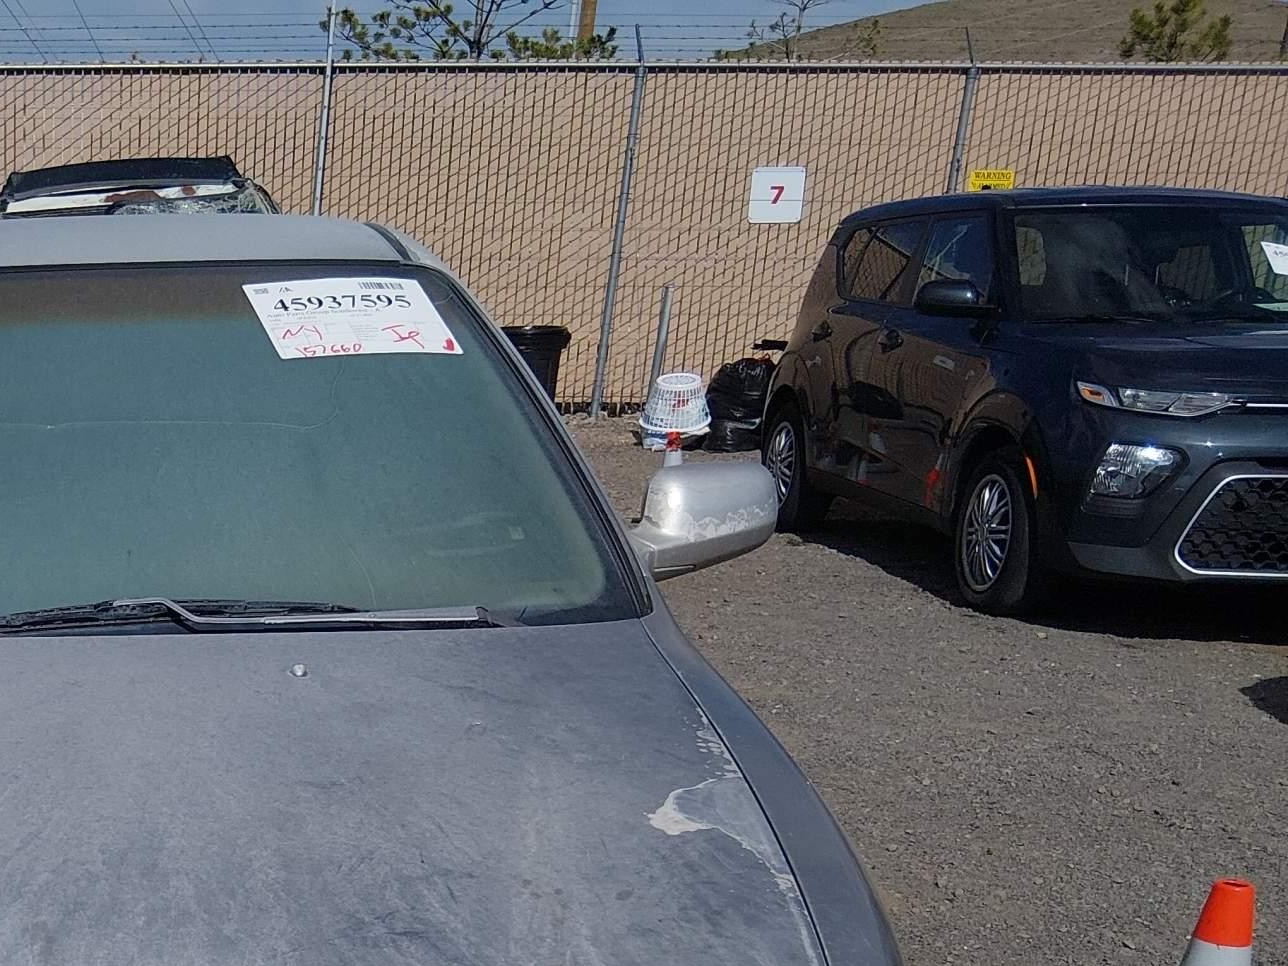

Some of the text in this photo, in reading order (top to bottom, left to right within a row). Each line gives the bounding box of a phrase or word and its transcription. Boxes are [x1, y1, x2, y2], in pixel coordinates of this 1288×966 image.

[974, 171, 1012, 180] WARNING
[770, 185, 785, 205] 7
[273, 294, 412, 312] 45937595
